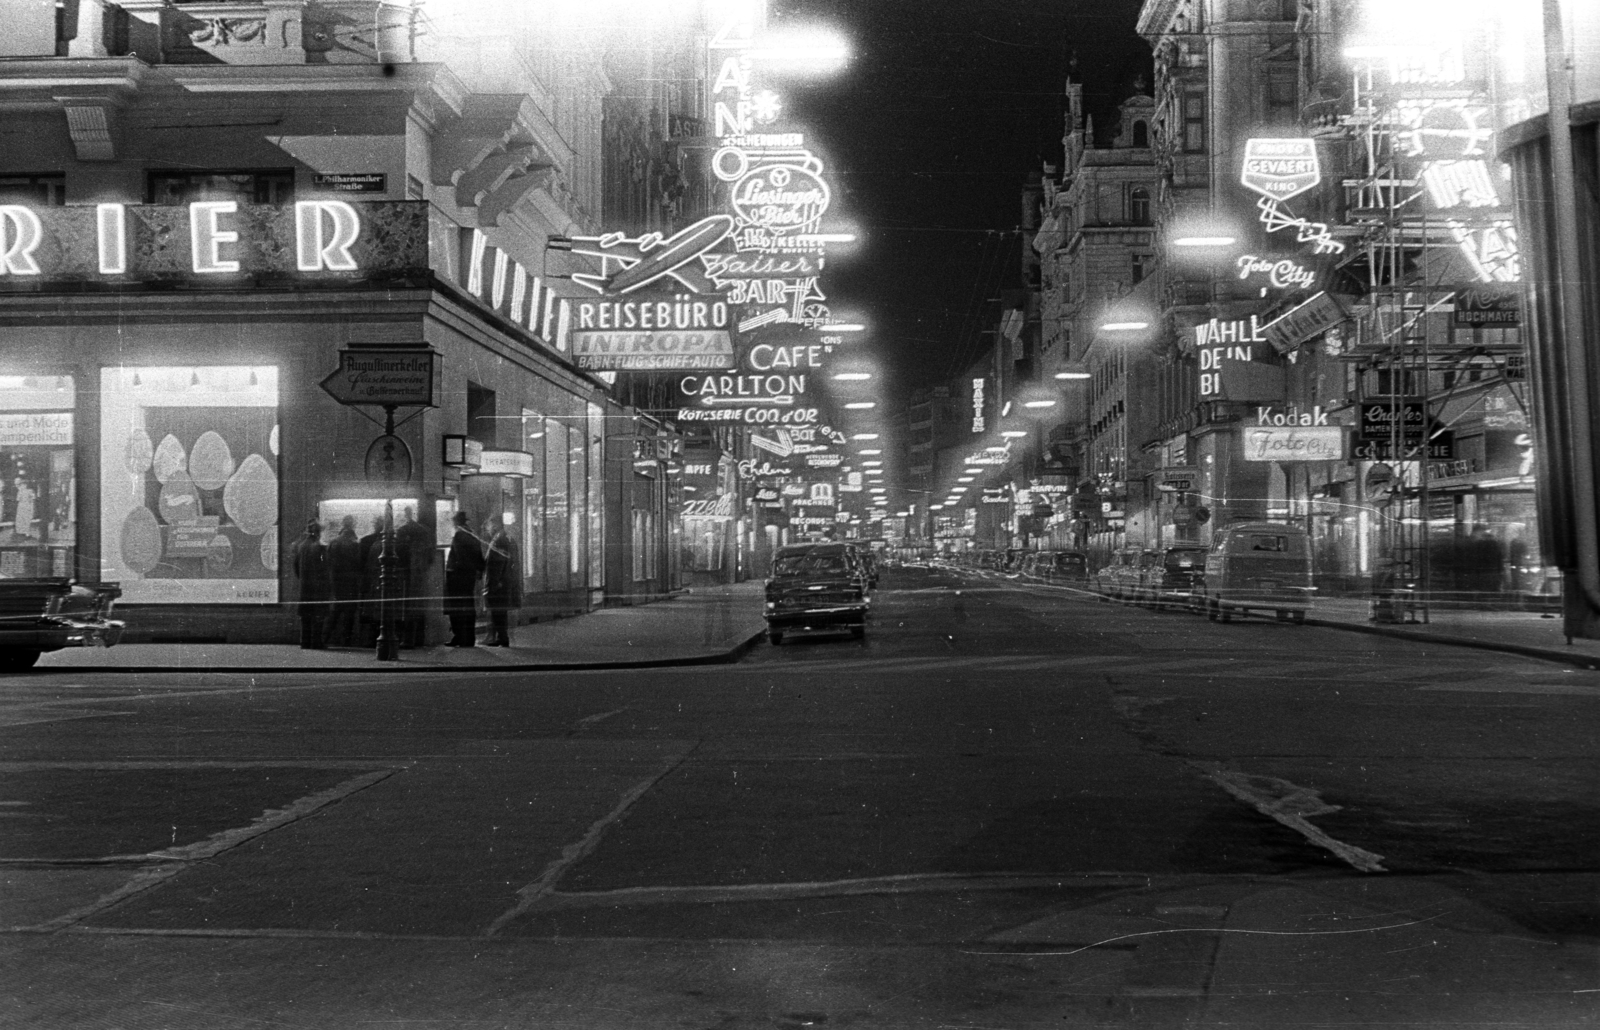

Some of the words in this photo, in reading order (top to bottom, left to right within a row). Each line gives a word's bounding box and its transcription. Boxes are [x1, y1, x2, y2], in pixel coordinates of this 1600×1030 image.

[1248, 159, 1314, 173] GEVAERT
[1265, 182, 1298, 191] KINO
[1238, 254, 1274, 280] Foto
[1270, 259, 1316, 289] City
[580, 294, 727, 328] REISEBÜRO
[1458, 311, 1520, 322] HOCHMAYER
[580, 334, 725, 353] INTROPA
[680, 375, 805, 395] CARLTON
[744, 407, 779, 423] COQ
[1257, 405, 1328, 426] Kodak
